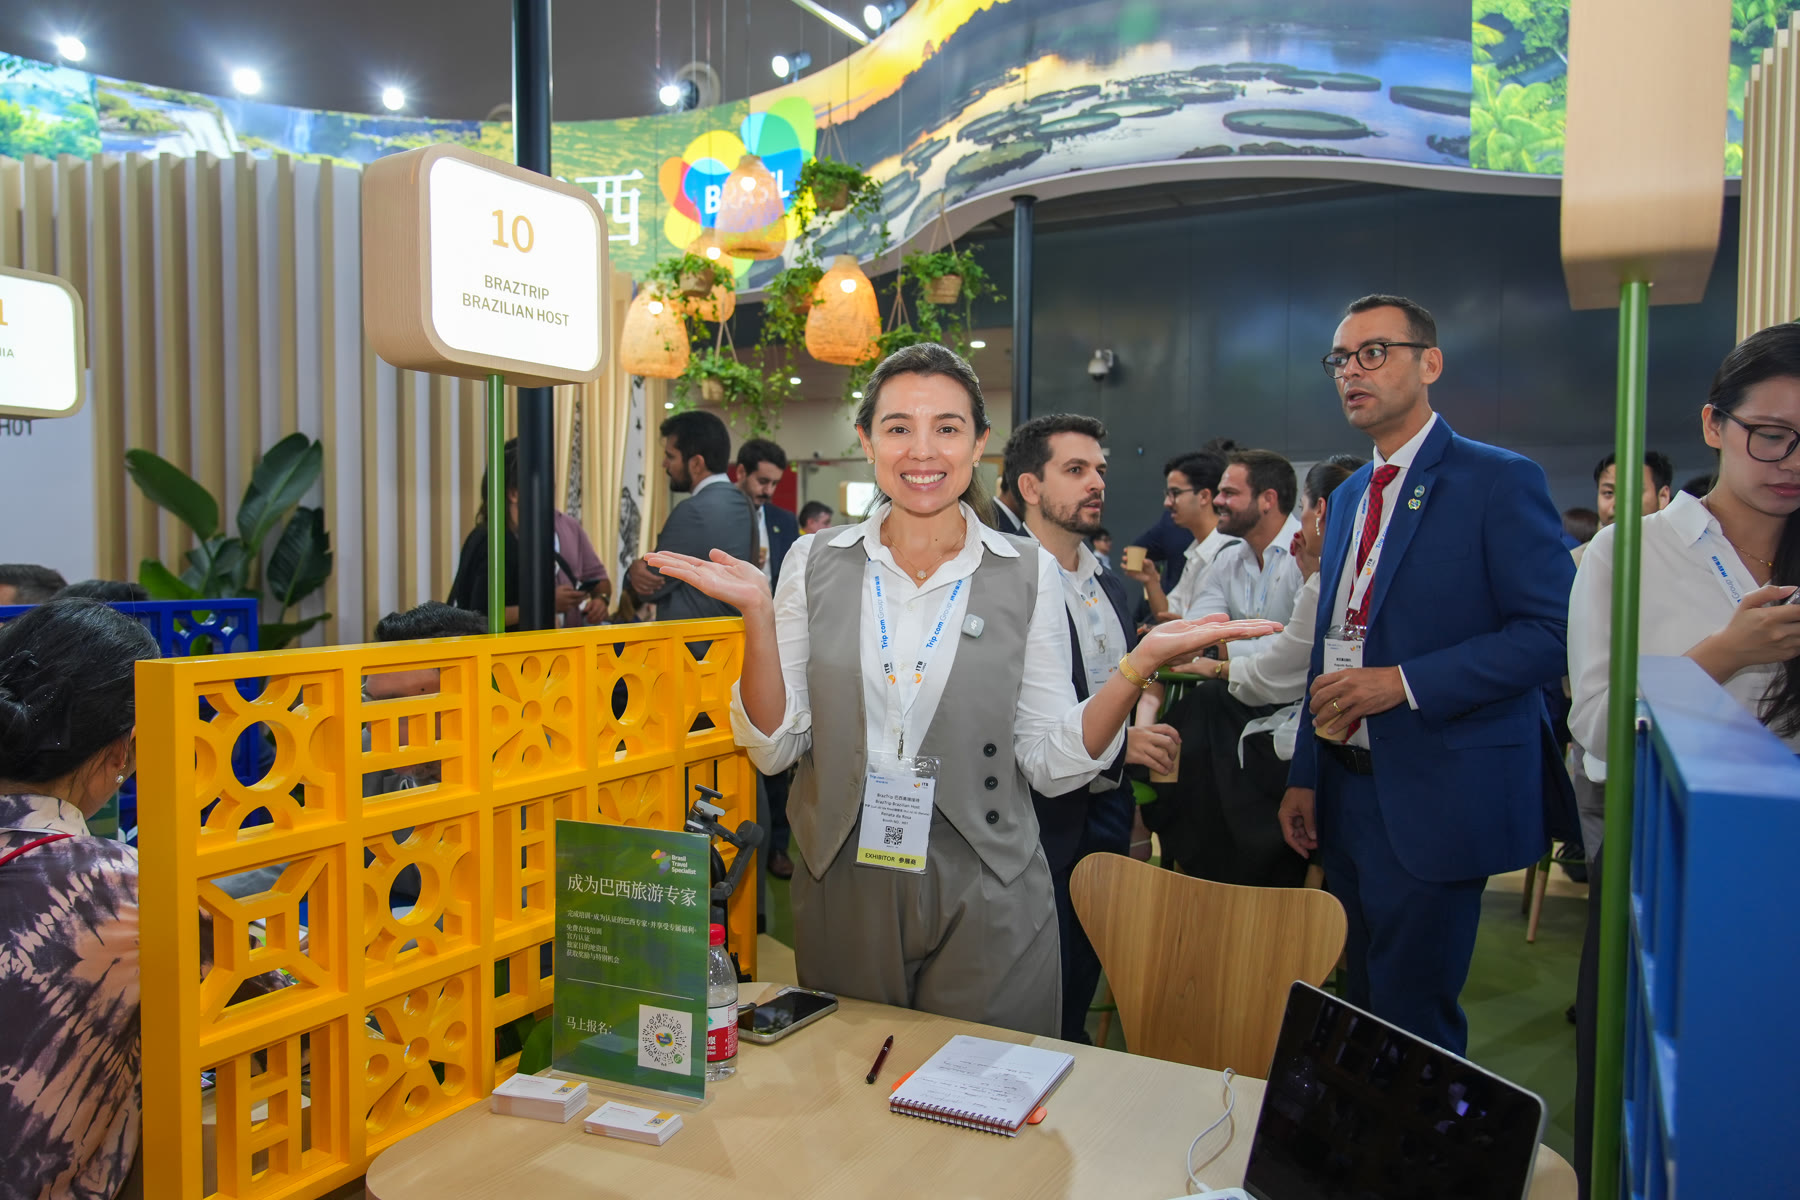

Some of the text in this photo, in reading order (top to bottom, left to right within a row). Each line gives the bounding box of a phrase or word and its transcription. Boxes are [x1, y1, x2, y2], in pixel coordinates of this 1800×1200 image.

[492, 209, 535, 253] 10
[484, 274, 550, 300] BRAZTRIP
[462, 292, 569, 327] BRAZILIAN HOST
[880, 619, 889, 649] Trip.com
[926, 621, 944, 648] Trip.com
[915, 661, 924, 671] ITB
[671, 854, 687, 862] Brasil
[671, 860, 688, 868] Travel
[671, 867, 697, 875] Specialist
[864, 852, 917, 866] EXHIBITOR 参展商
[567, 873, 697, 907] 成为巴西旅游专家
